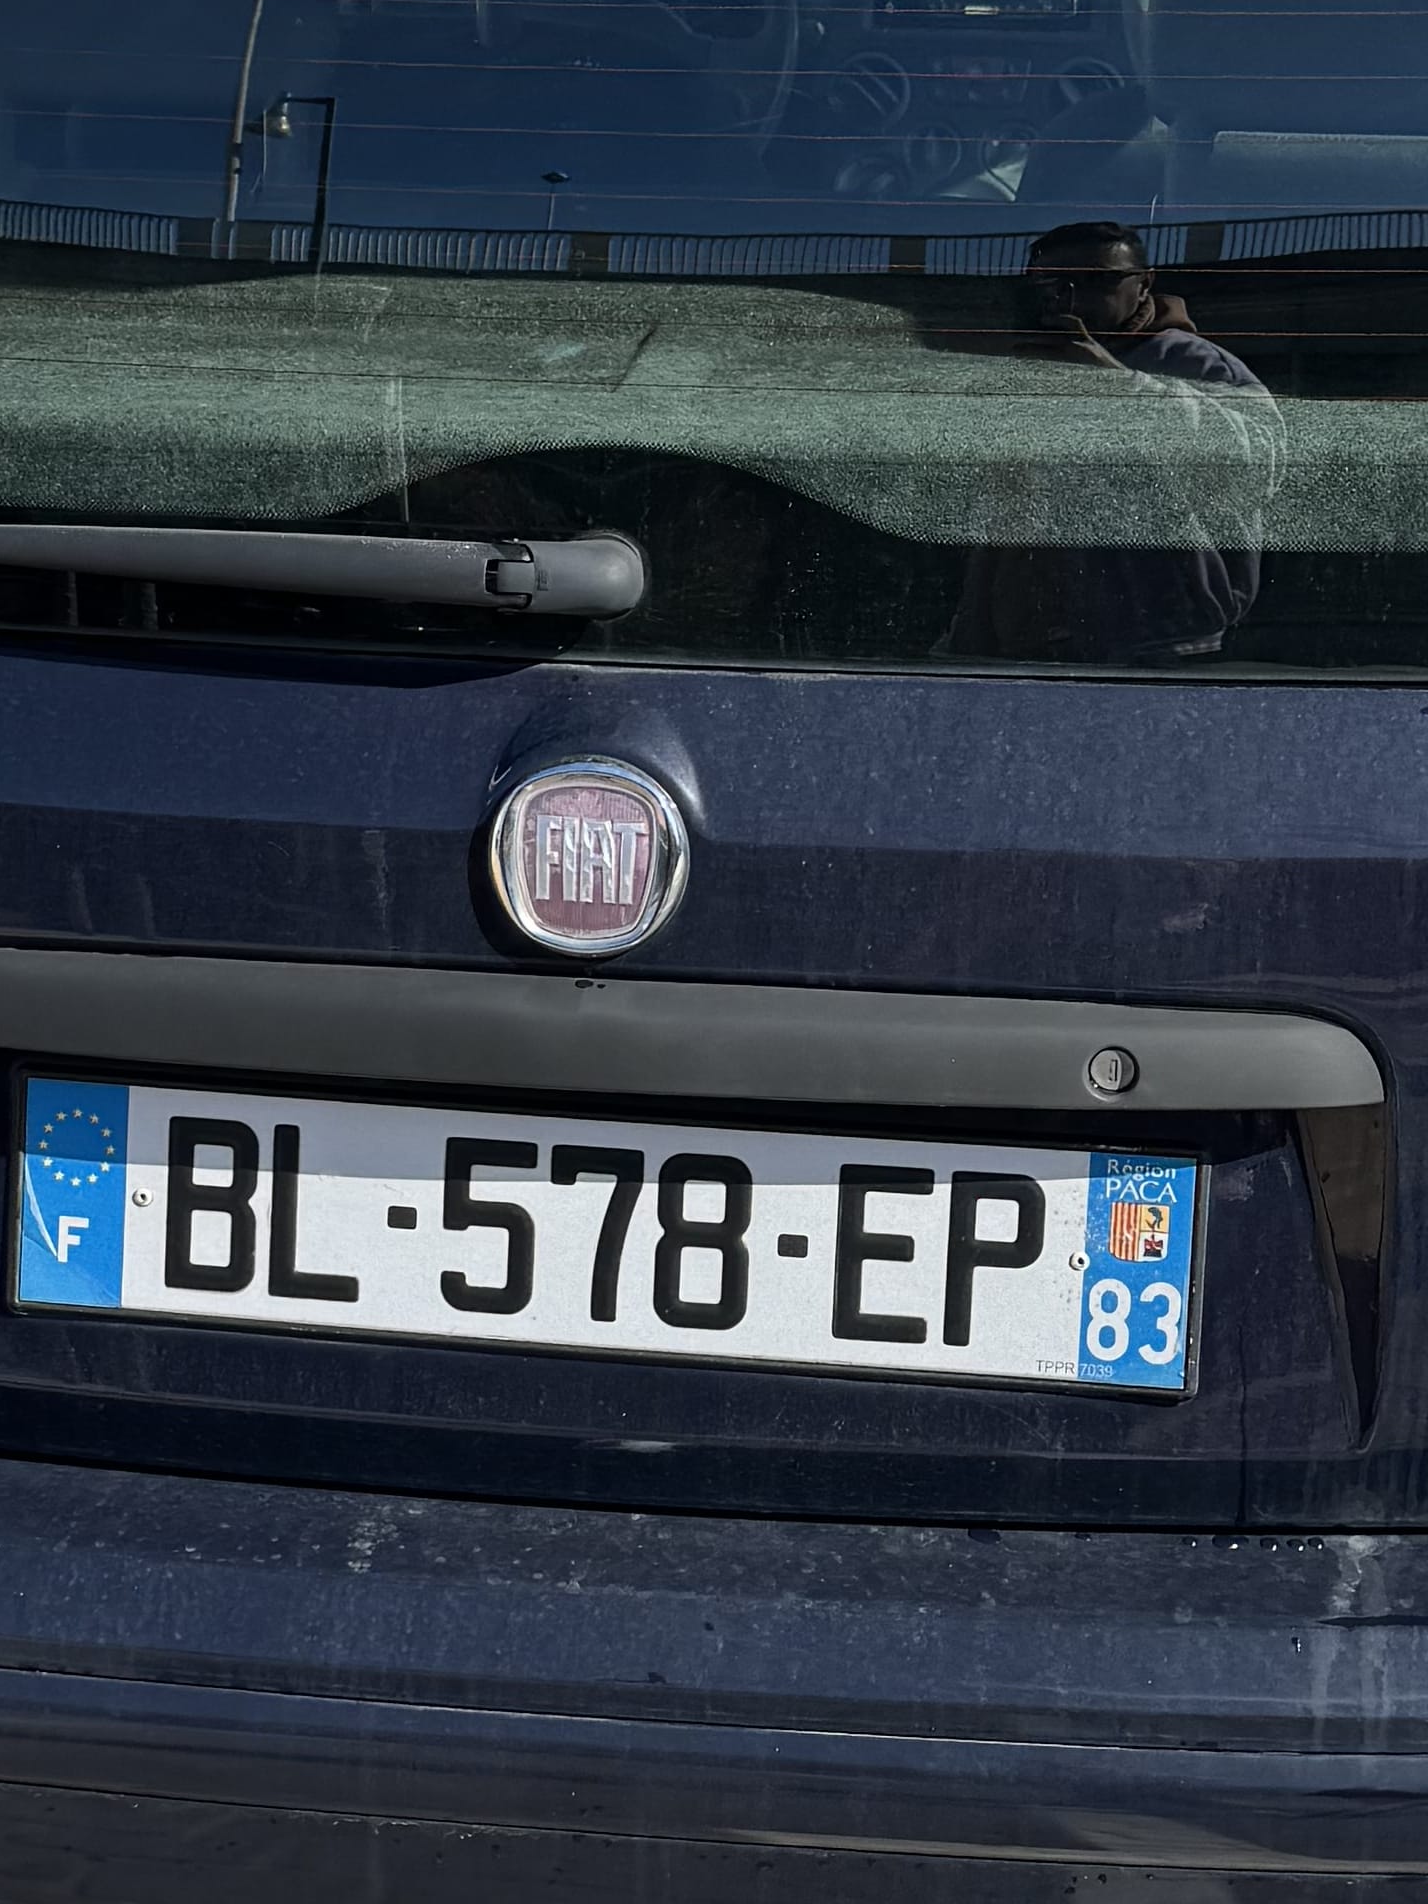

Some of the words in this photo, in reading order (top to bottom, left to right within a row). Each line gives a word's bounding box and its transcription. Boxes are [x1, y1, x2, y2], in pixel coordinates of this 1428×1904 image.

[535, 815, 649, 905] FIAT
[1107, 1159, 1177, 1182] Région
[1105, 1179, 1178, 1203] PACA
[55, 1215, 90, 1263] F
[1087, 1278, 1182, 1365] 83
[1036, 1359, 1075, 1375] TPPR
[1079, 1363, 1114, 1378] 7039
